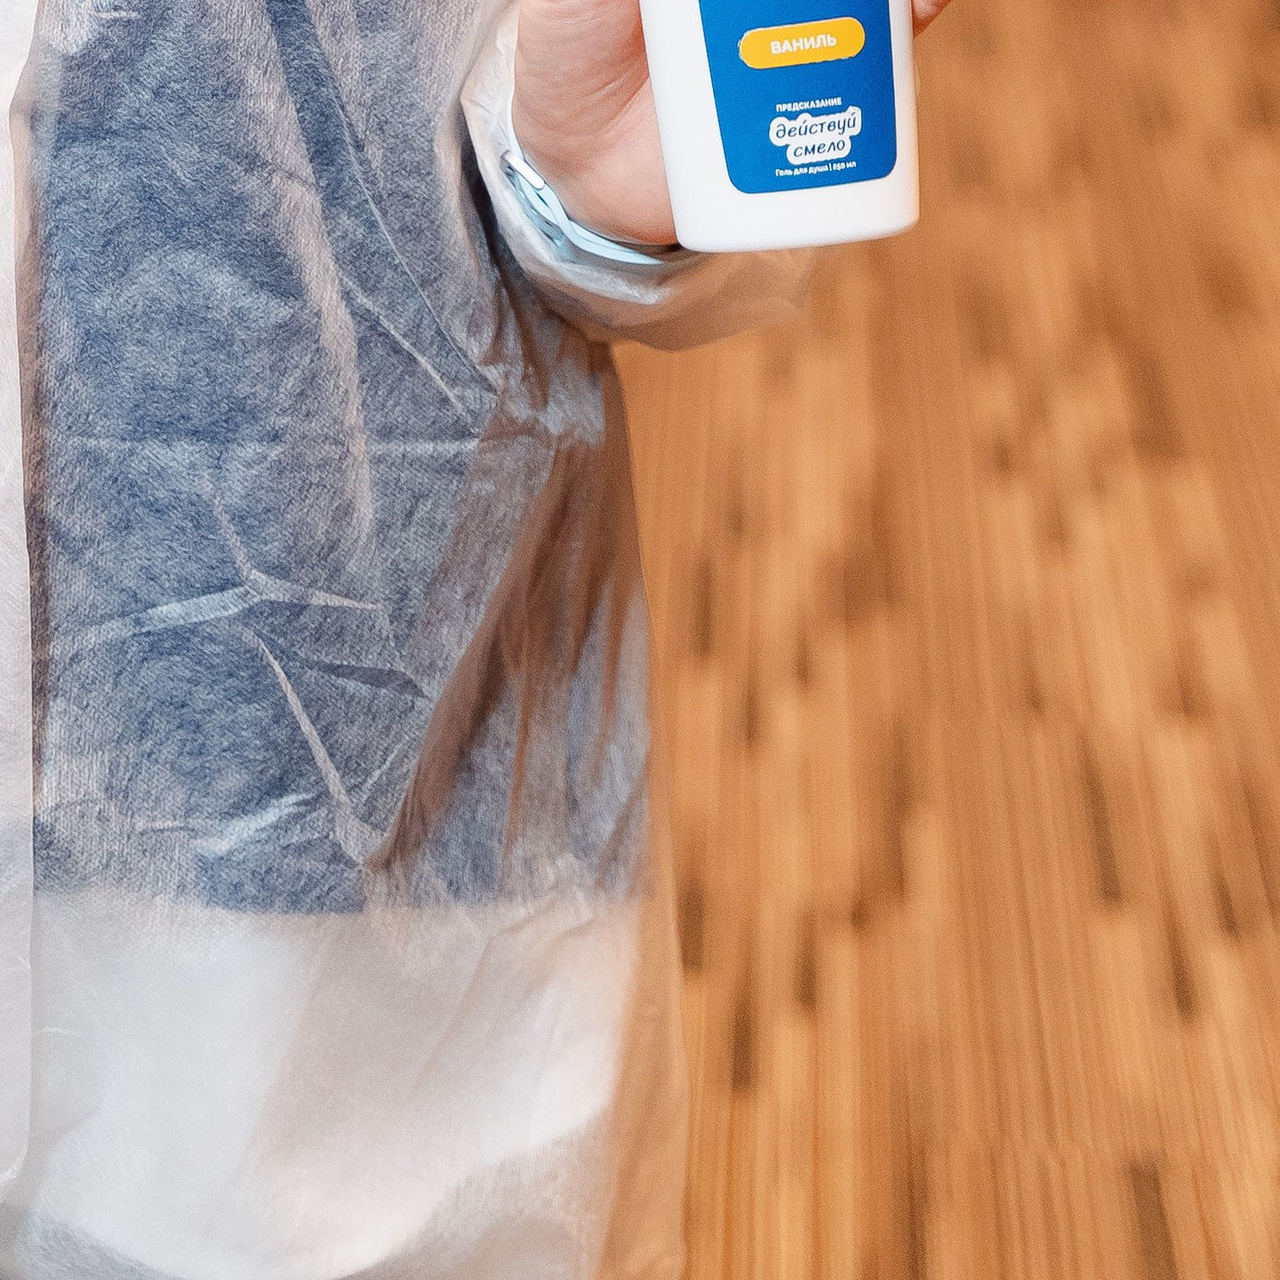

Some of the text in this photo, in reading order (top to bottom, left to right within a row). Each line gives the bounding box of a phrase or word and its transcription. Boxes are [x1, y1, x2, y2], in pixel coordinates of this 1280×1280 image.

[770, 33, 837, 55] ВАНИЛЬ
[775, 97, 842, 112] ПРЕДСКАЗАНИЕ
[775, 111, 856, 139] действуй
[793, 139, 846, 157] смело
